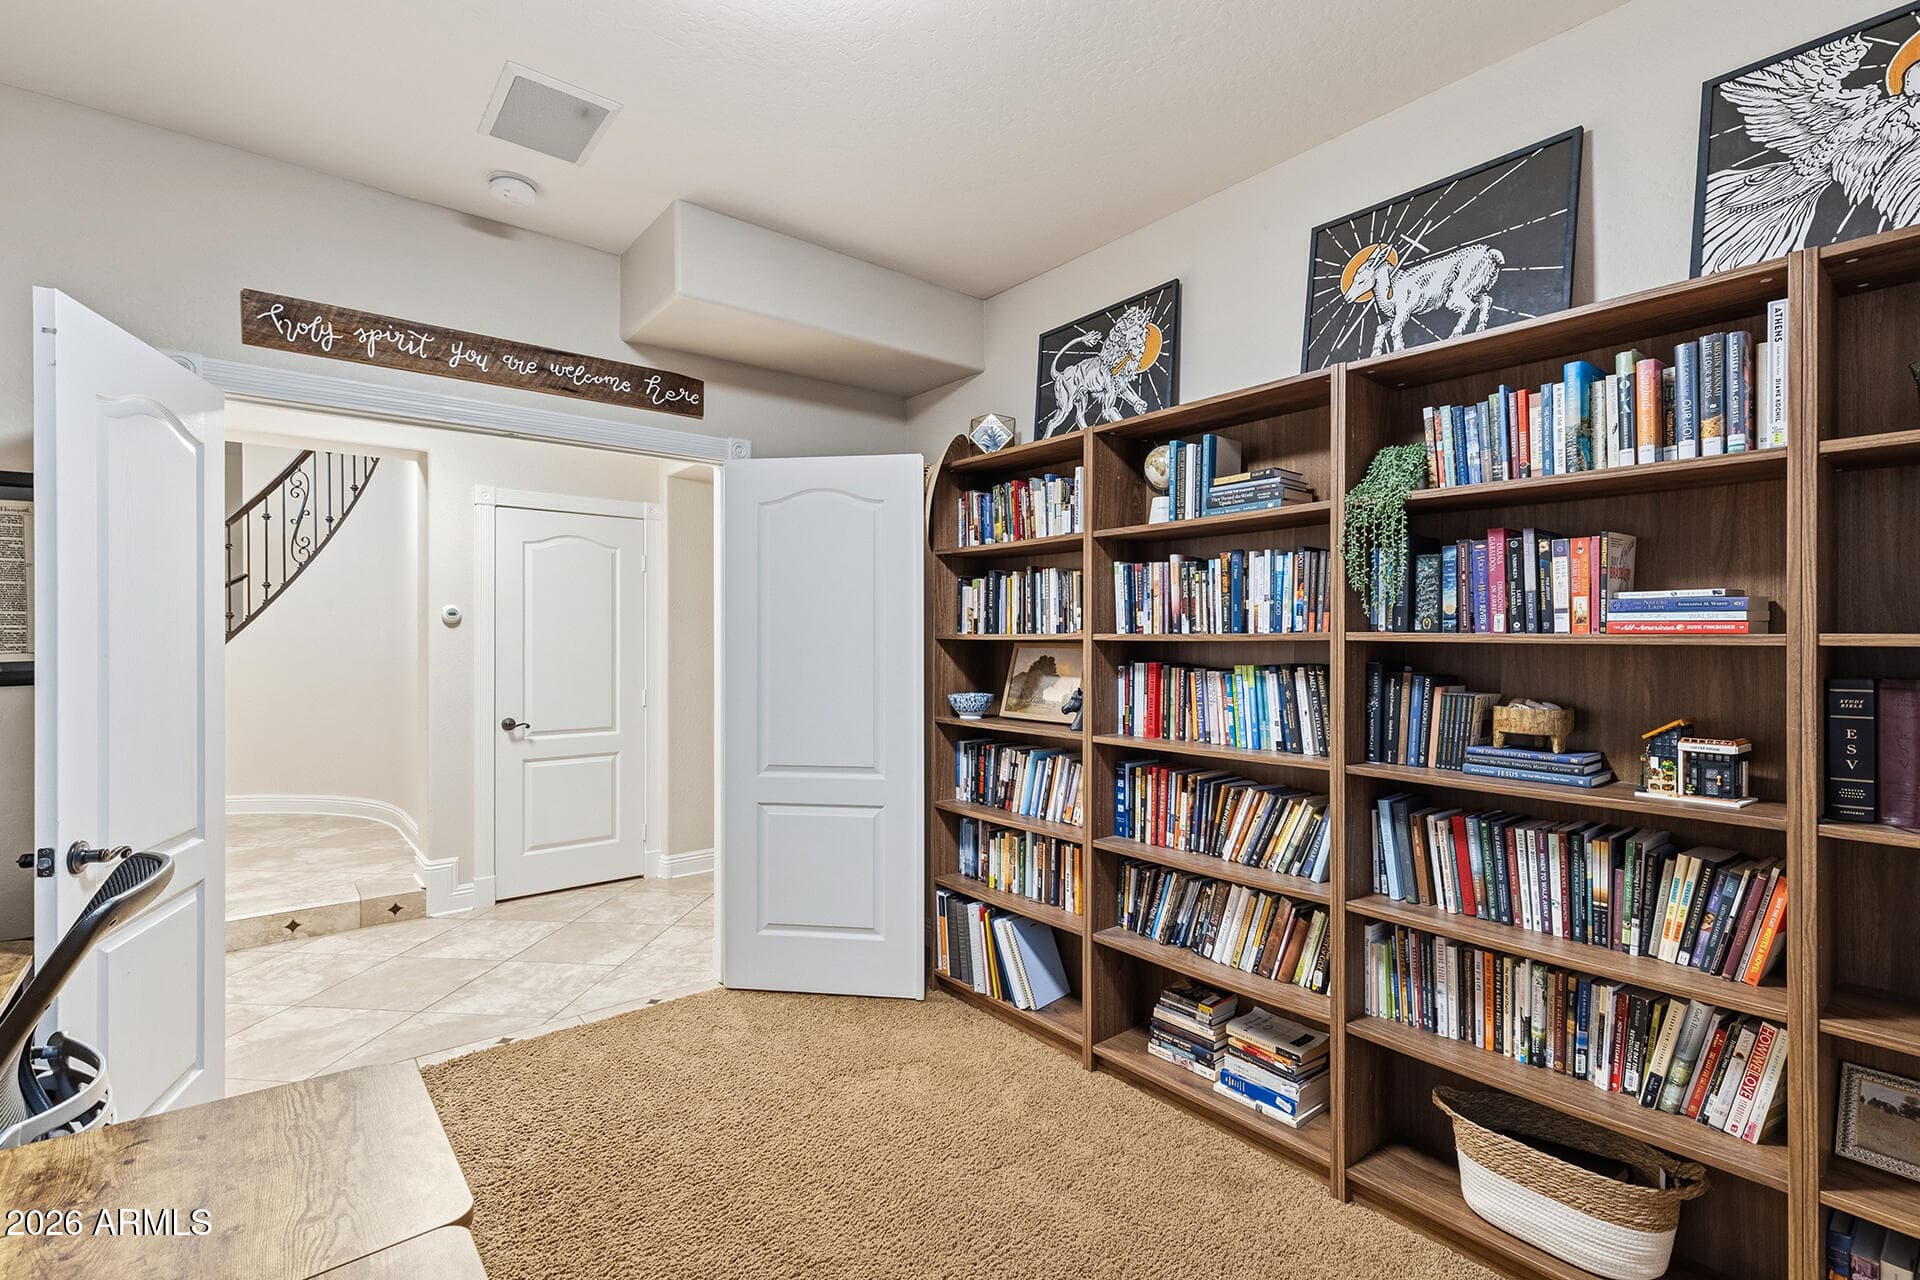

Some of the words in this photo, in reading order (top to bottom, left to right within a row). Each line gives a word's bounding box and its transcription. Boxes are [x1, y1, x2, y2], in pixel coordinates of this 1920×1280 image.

[1774, 307, 1783, 343] ATHENS
[258, 304, 342, 351] holy
[353, 322, 435, 358] spirit
[449, 342, 489, 373] you
[503, 355, 537, 374] are
[550, 363, 631, 392] welcome
[644, 374, 699, 405] here
[1682, 399, 1691, 419] OUR
[1682, 422, 1692, 441] HOU
[1759, 927, 1773, 949] WRITES
[1750, 953, 1763, 974] NOVEL
[1755, 1026, 1774, 1054] HOW
[1748, 1054, 1765, 1070] WE
[1740, 1071, 1758, 1099] LOVE
